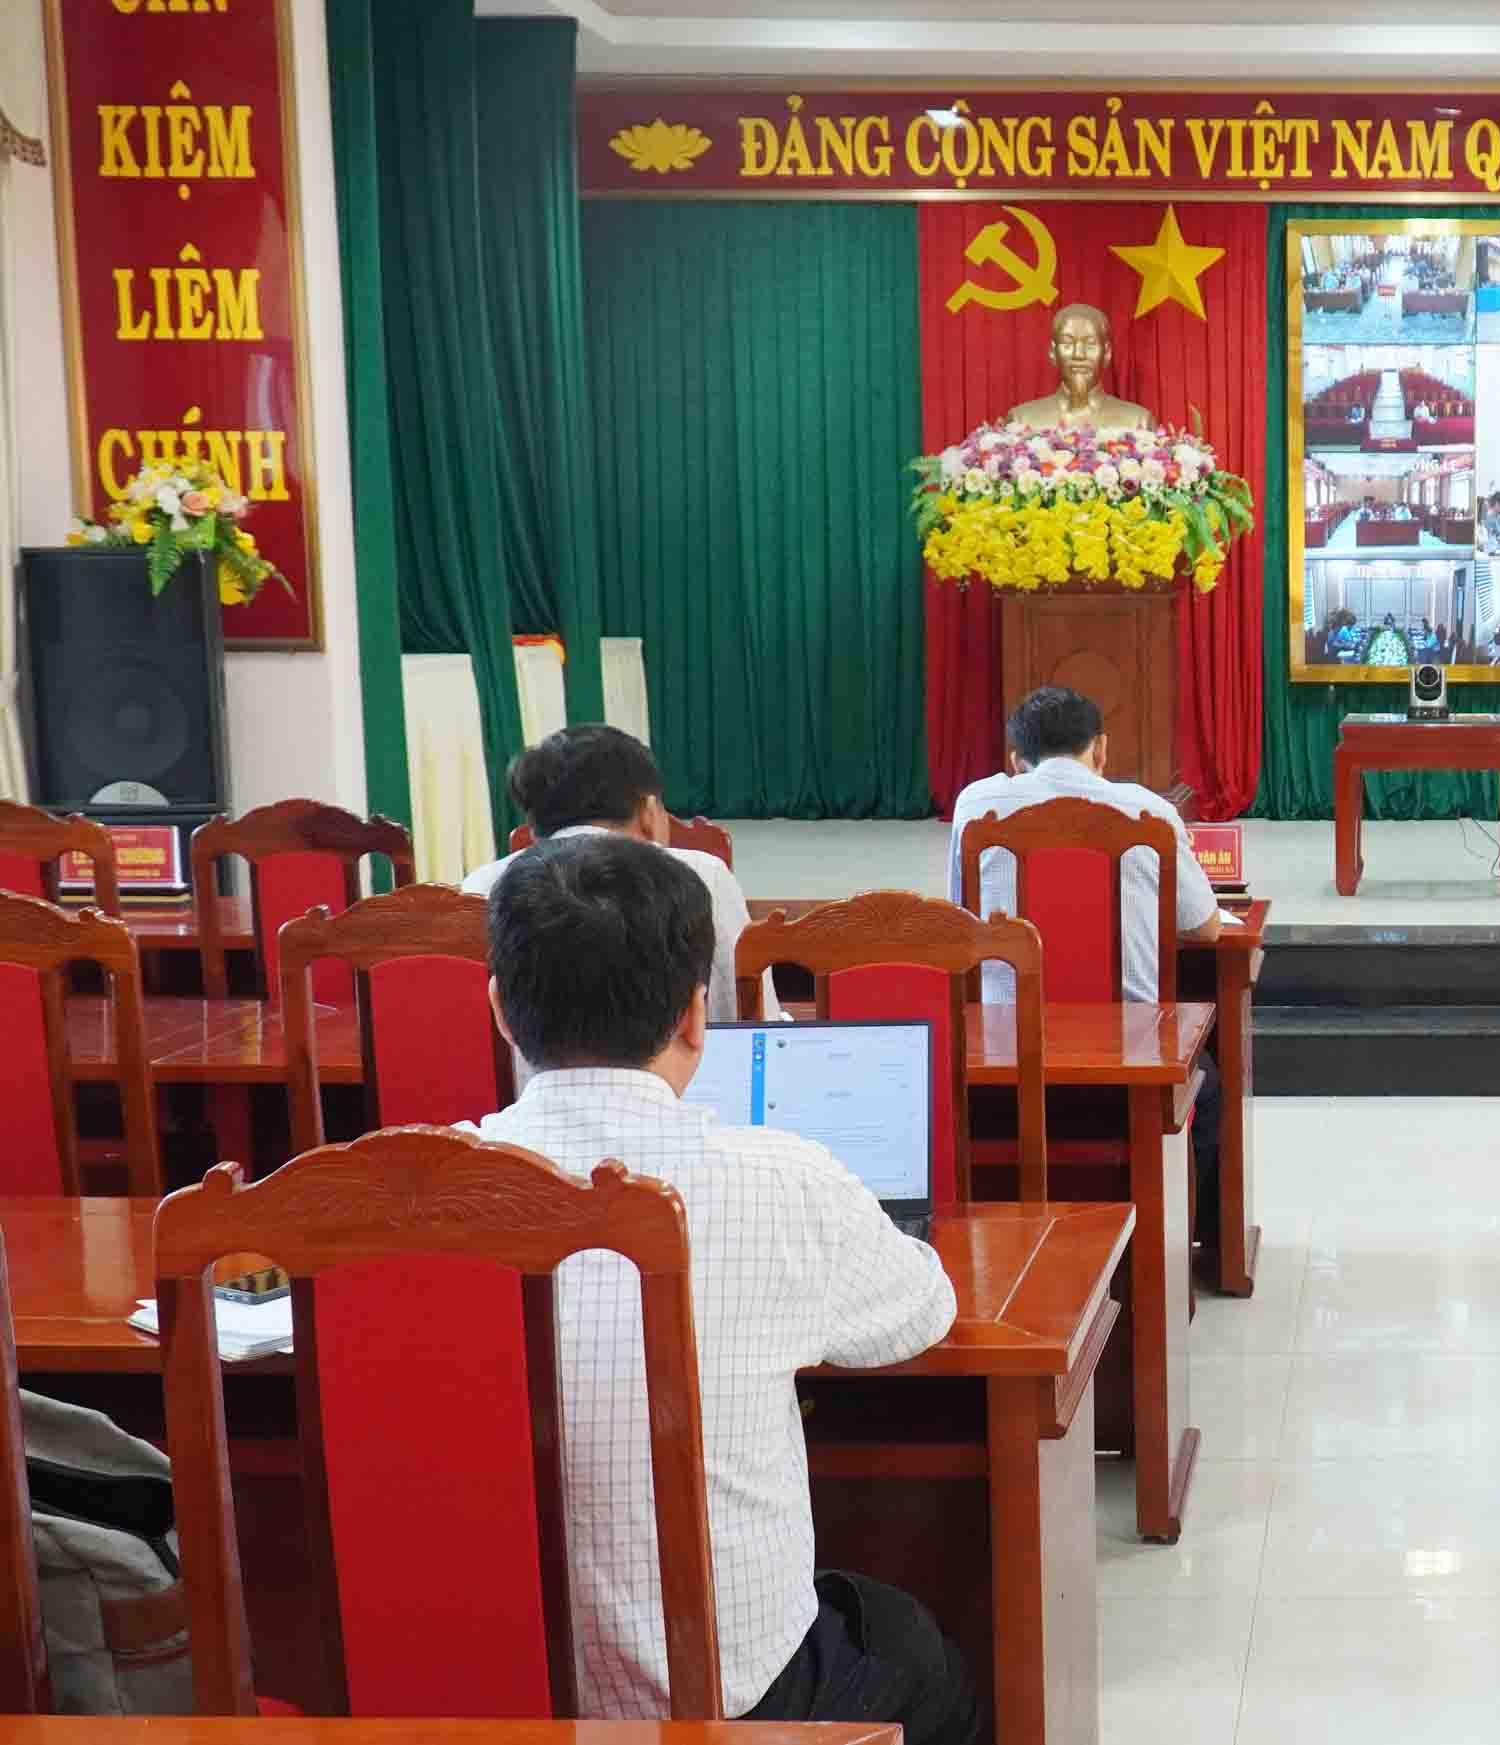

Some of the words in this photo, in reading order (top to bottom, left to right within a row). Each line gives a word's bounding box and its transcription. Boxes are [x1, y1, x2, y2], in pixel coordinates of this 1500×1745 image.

[97, 80, 256, 200] KIỆM
[738, 94, 895, 177] ĐẢNG
[904, 98, 1057, 189] CỘNG
[1066, 97, 1176, 177] SẢN
[1185, 101, 1320, 190] VIỆT
[1330, 119, 1455, 179] NAM
[112, 243, 264, 341] LIÊM
